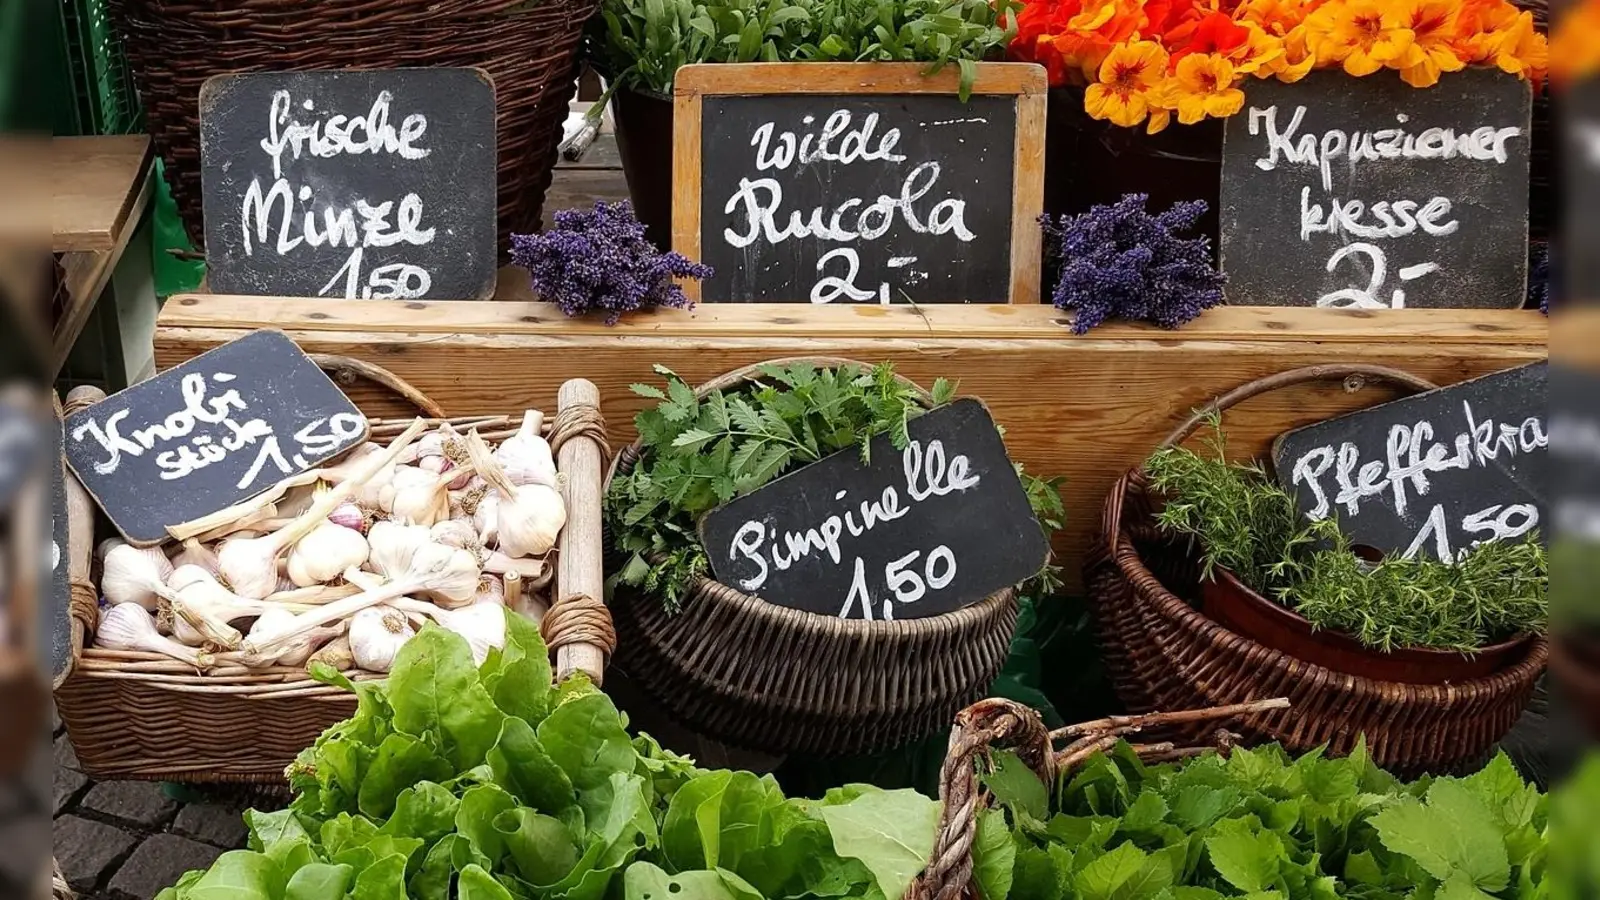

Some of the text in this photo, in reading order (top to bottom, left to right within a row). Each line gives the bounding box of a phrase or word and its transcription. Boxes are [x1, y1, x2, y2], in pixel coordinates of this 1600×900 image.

[260, 89, 432, 179] frische
[242, 177, 436, 256] Minze
[723, 161, 977, 248] Rucola
[838, 544, 957, 621] 1,50
